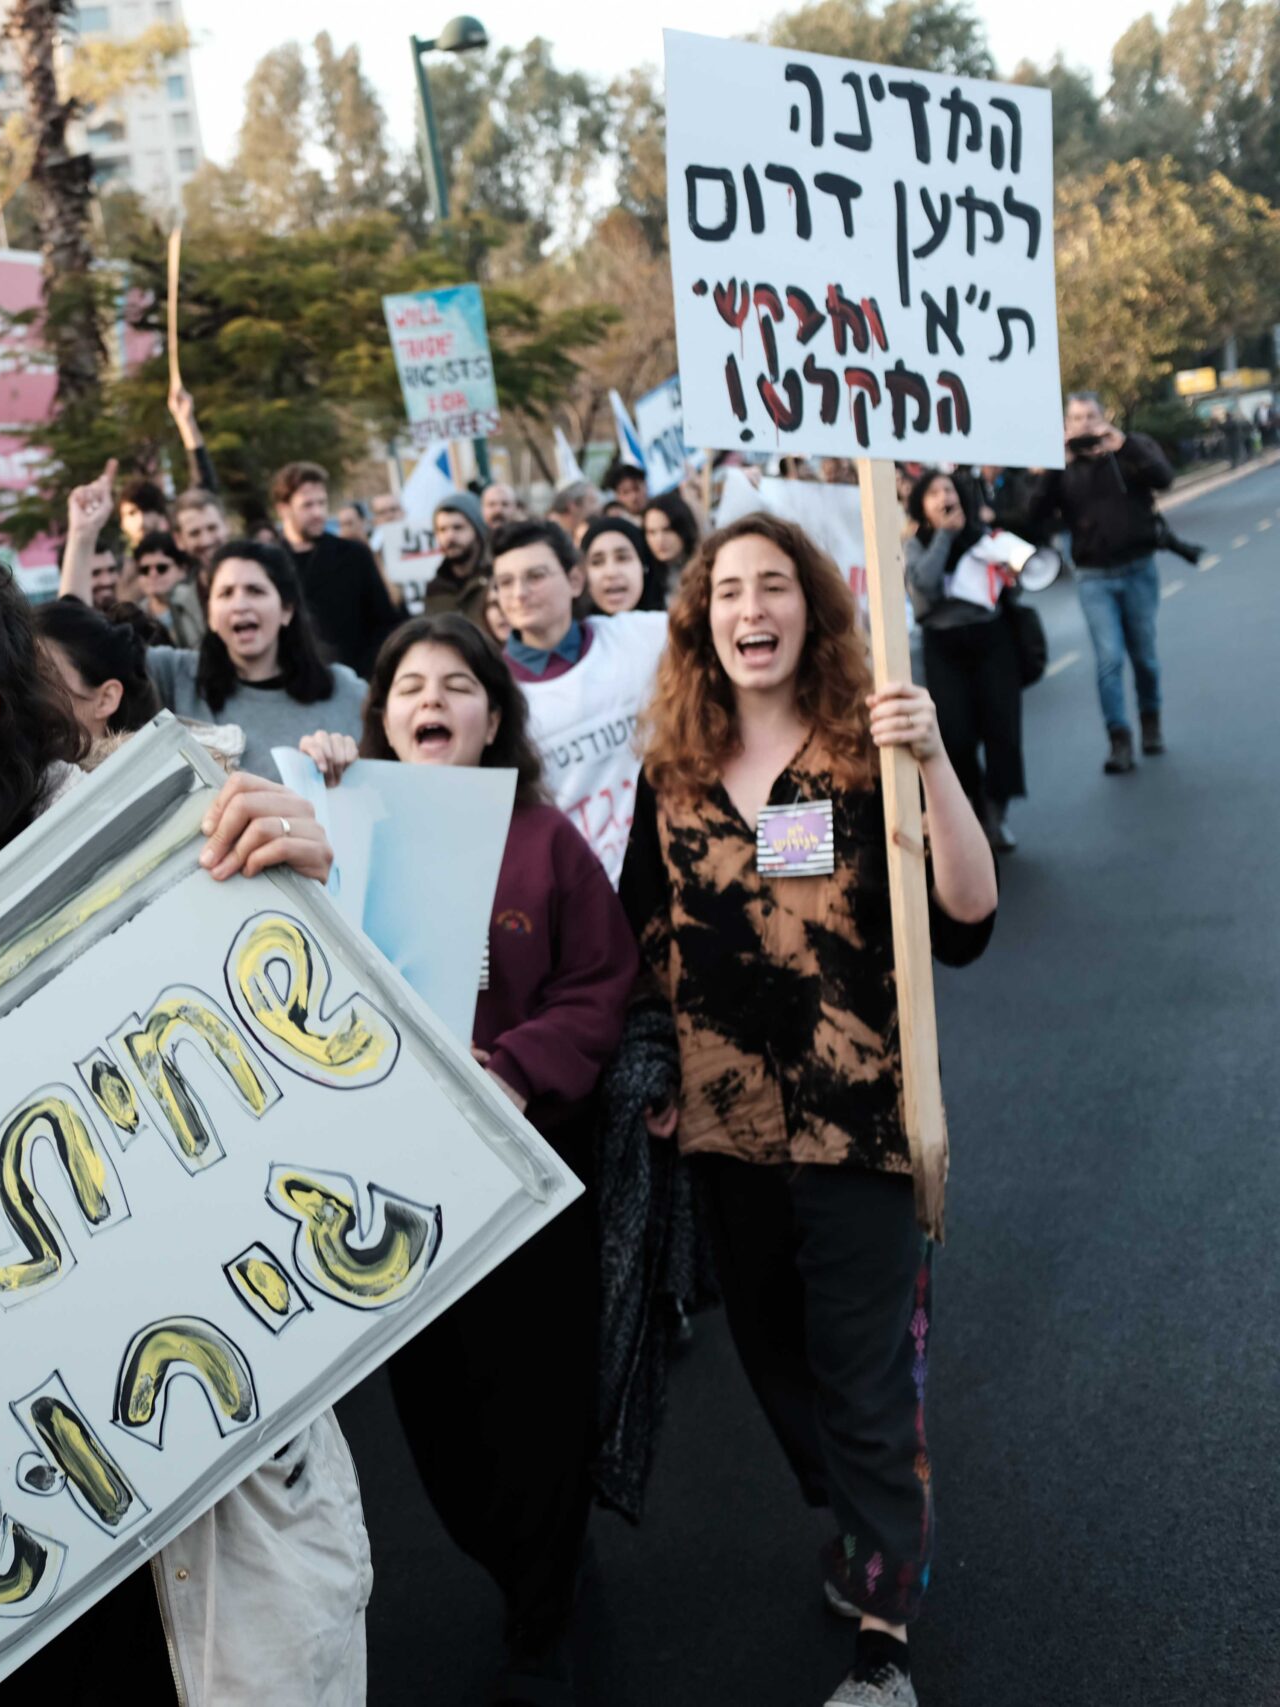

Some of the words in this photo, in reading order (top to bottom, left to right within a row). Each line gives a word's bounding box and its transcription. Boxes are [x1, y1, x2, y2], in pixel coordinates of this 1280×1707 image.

[784, 62, 1022, 174] המדינה
[684, 162, 862, 242] דרום
[893, 180, 1041, 308] למען
[691, 276, 889, 384] ומבקשי
[724, 352, 972, 448] המקלט!
